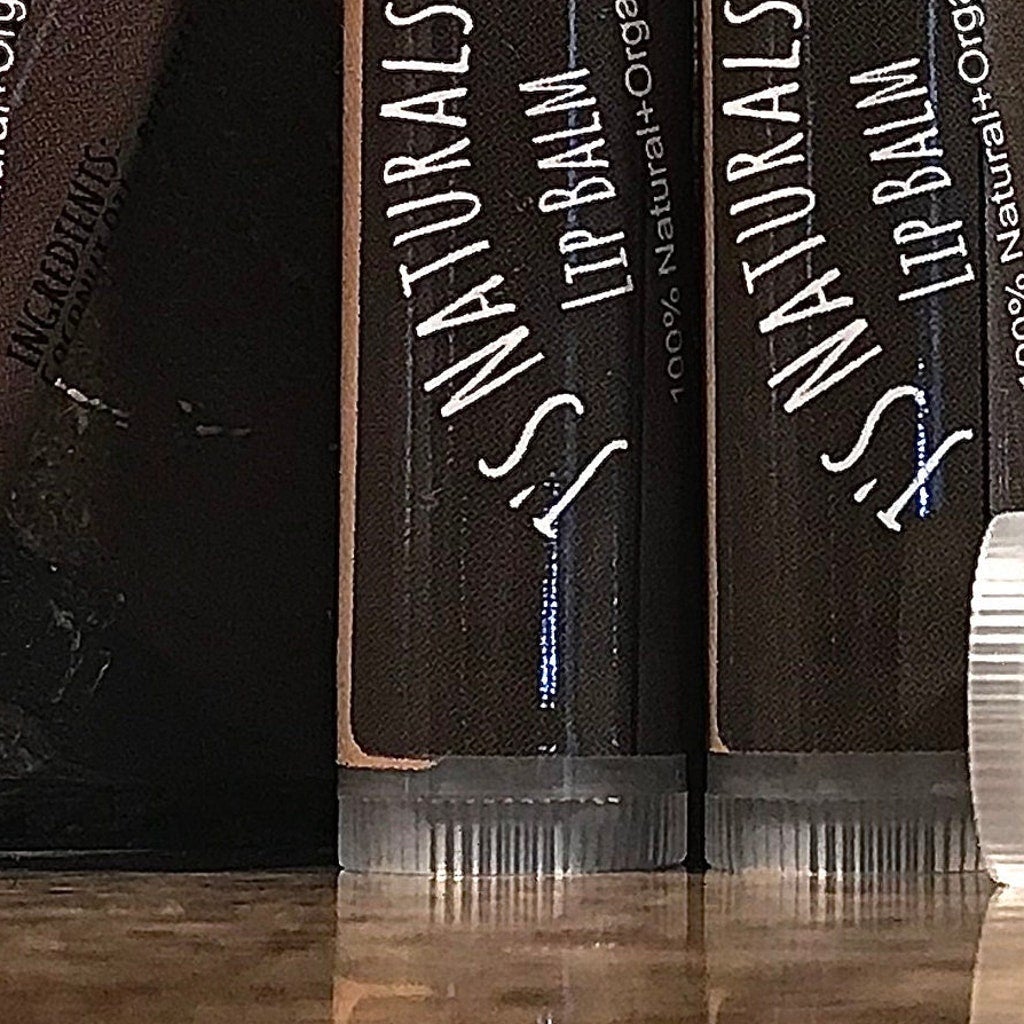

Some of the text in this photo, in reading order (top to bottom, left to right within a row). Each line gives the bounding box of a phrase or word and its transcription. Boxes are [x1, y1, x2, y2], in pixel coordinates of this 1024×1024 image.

[7, 138, 119, 370] INGREDIENTS:
[380, 1, 545, 418] NATURALS
[519, 68, 635, 310] LIP BALM
[722, 0, 883, 413] NATURALS
[849, 57, 975, 301] LIP BALM
[661, 286, 686, 403] 100%
